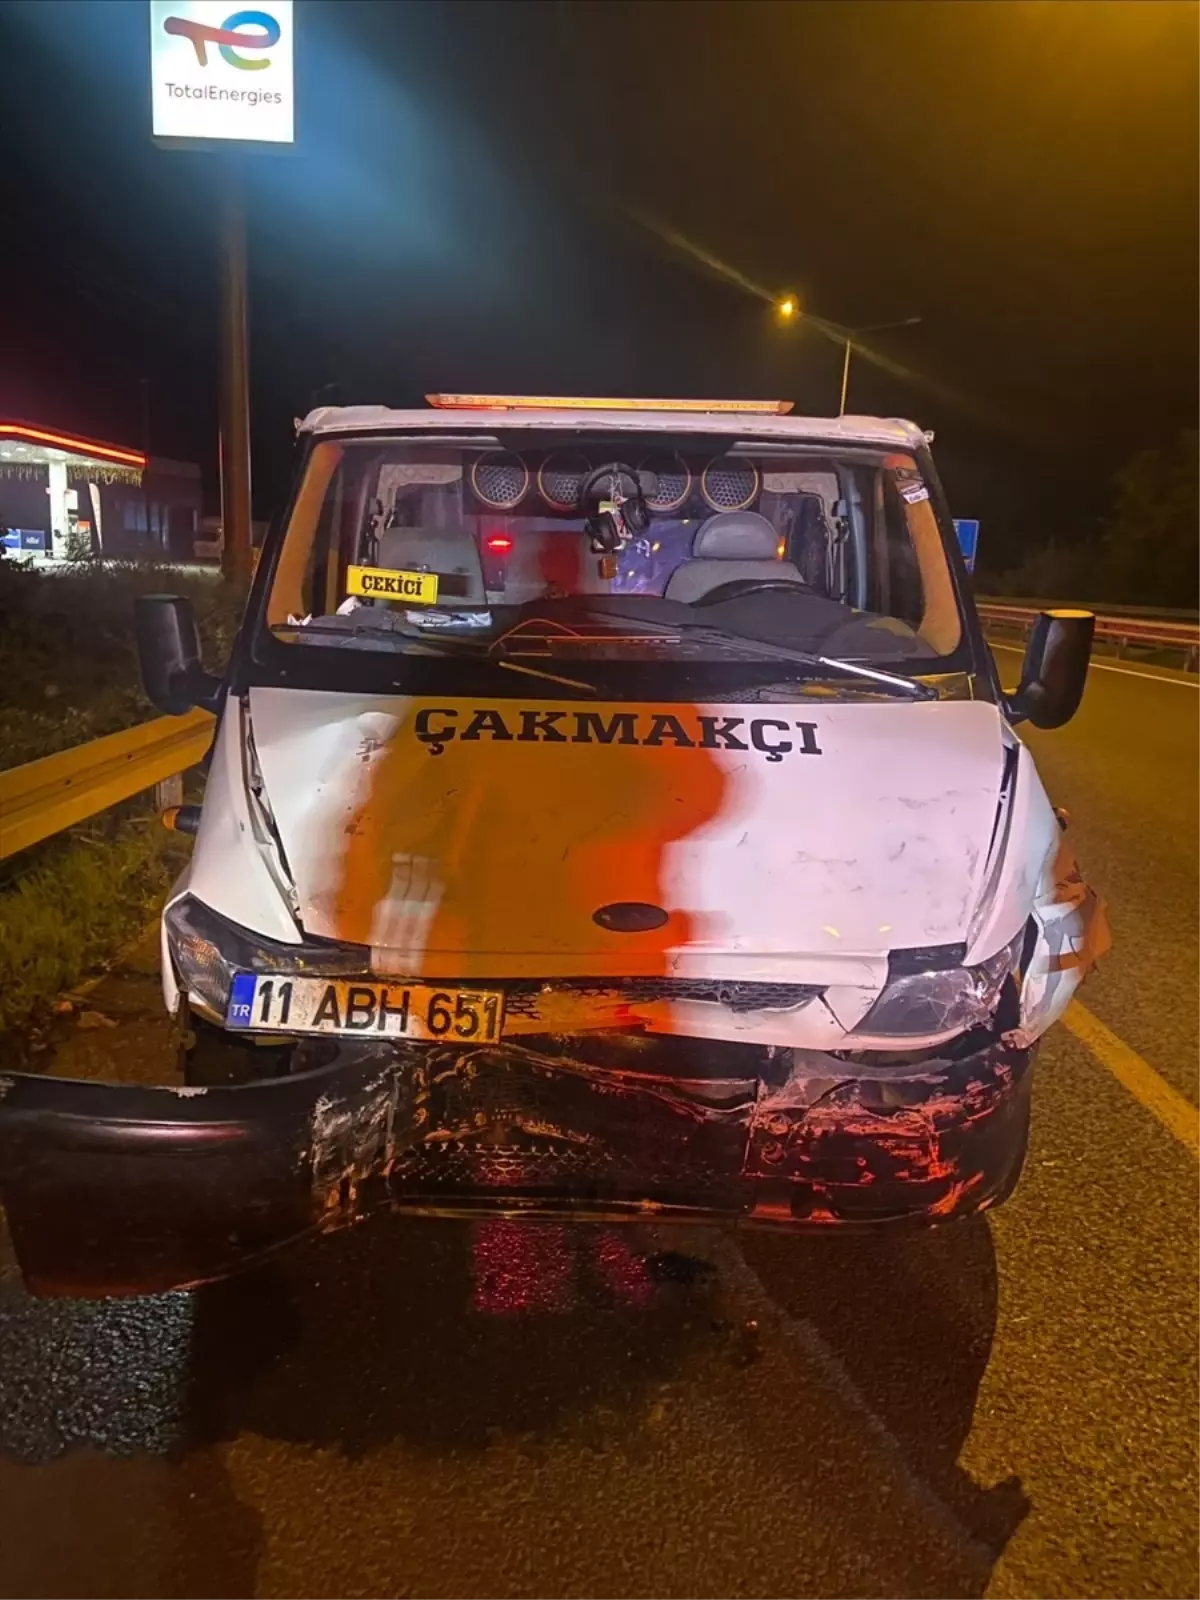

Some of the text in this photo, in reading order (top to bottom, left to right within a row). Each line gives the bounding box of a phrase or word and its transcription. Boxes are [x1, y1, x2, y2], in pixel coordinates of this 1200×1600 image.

[165, 83, 282, 106] TotalEnergies
[361, 574, 422, 595] ÇEKİCİ
[414, 708, 823, 762] ÇAKMAKÇI
[231, 980, 498, 1039] TR 11 ABH 651
